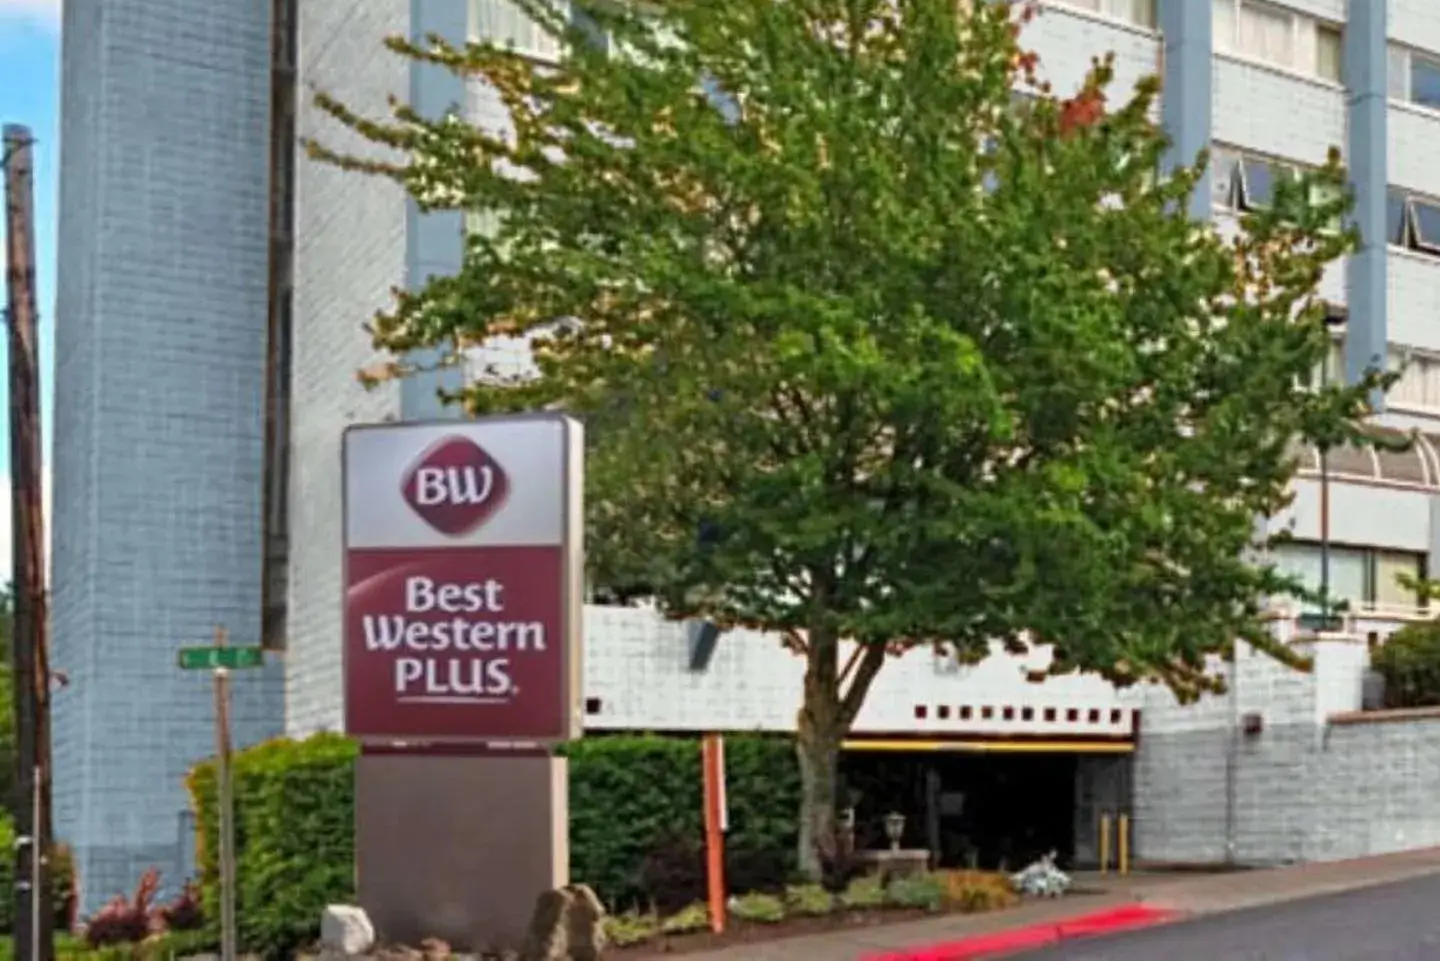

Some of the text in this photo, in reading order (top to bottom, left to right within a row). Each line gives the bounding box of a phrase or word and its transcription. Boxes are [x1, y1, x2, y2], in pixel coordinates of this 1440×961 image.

[416, 466, 493, 506] BW
[405, 576, 505, 613] Best
[363, 615, 547, 651] Western
